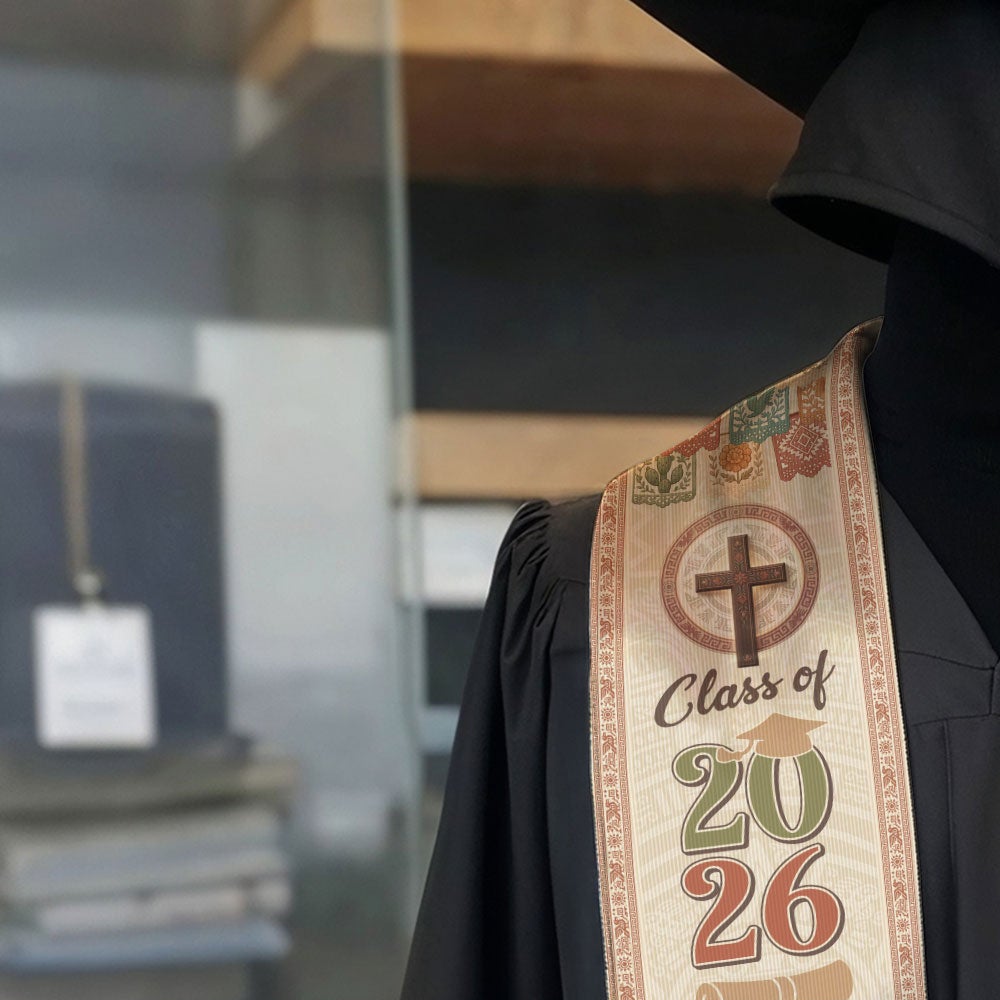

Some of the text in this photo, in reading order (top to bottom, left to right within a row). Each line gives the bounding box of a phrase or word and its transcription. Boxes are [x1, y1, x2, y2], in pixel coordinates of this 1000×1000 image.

[654, 649, 836, 728] Class of
[671, 743, 834, 856] 20
[680, 842, 846, 970] 26
